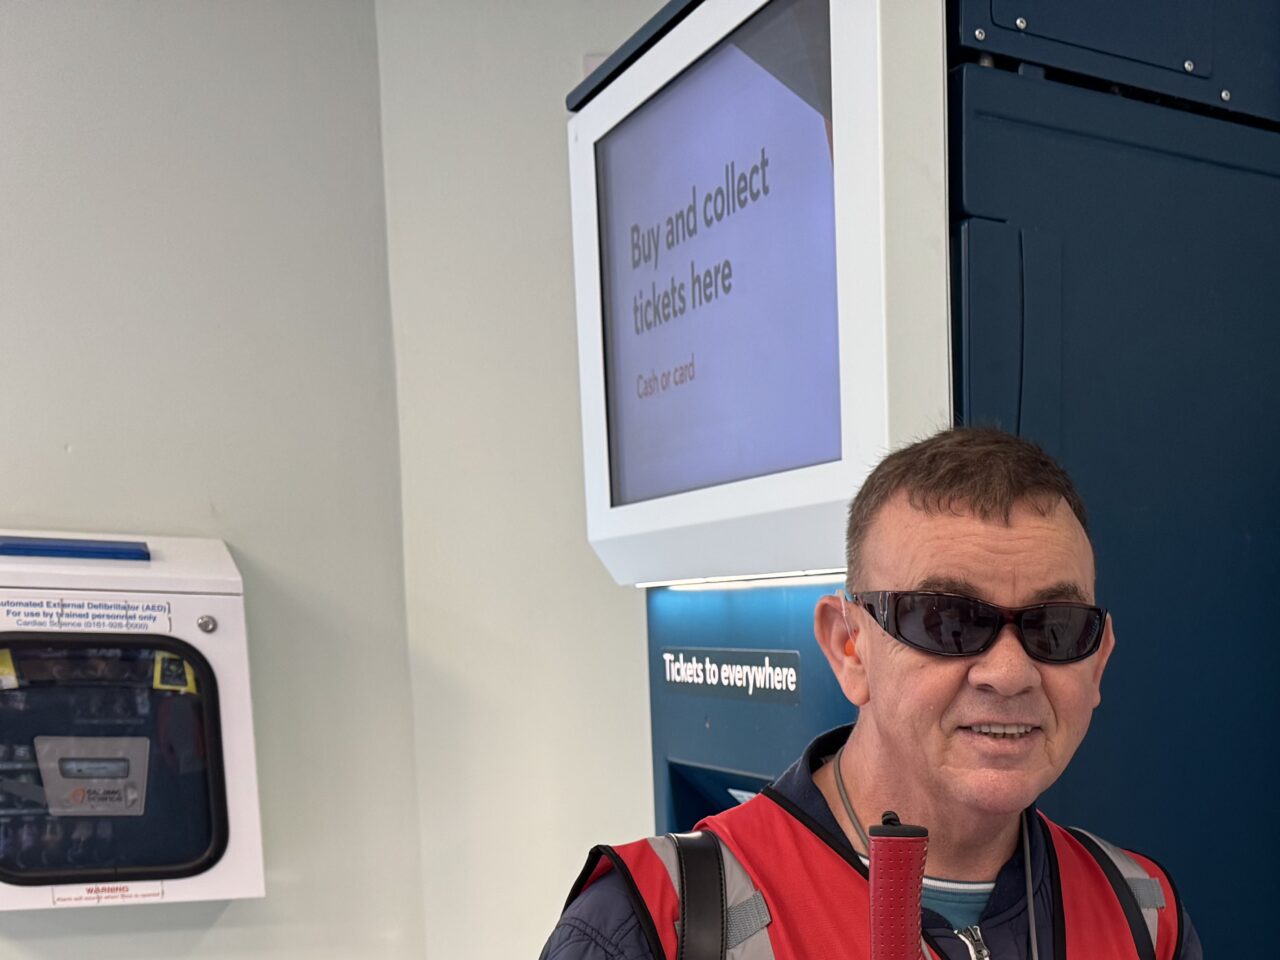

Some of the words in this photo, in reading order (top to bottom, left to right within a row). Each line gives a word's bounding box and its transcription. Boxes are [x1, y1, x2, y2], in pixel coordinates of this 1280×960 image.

[630, 223, 660, 270] Buy
[666, 185, 697, 251] and
[703, 147, 770, 228] collect
[633, 276, 686, 336] tickets
[691, 259, 732, 310] here
[636, 368, 659, 399] Cash
[660, 371, 671, 391] or
[673, 352, 695, 386] card
[6, 609, 21, 617] For
[42, 610, 53, 620] by
[56, 611, 90, 619] trained
[91, 612, 137, 622] personnel
[138, 613, 157, 622] only
[46, 601, 85, 609] External
[87, 602, 139, 611] Defibrillator
[141, 604, 168, 613] (AED)
[663, 652, 704, 684] Tickets
[705, 657, 719, 685] to
[720, 656, 797, 695] everywhere
[86, 885, 129, 894] WARNING
